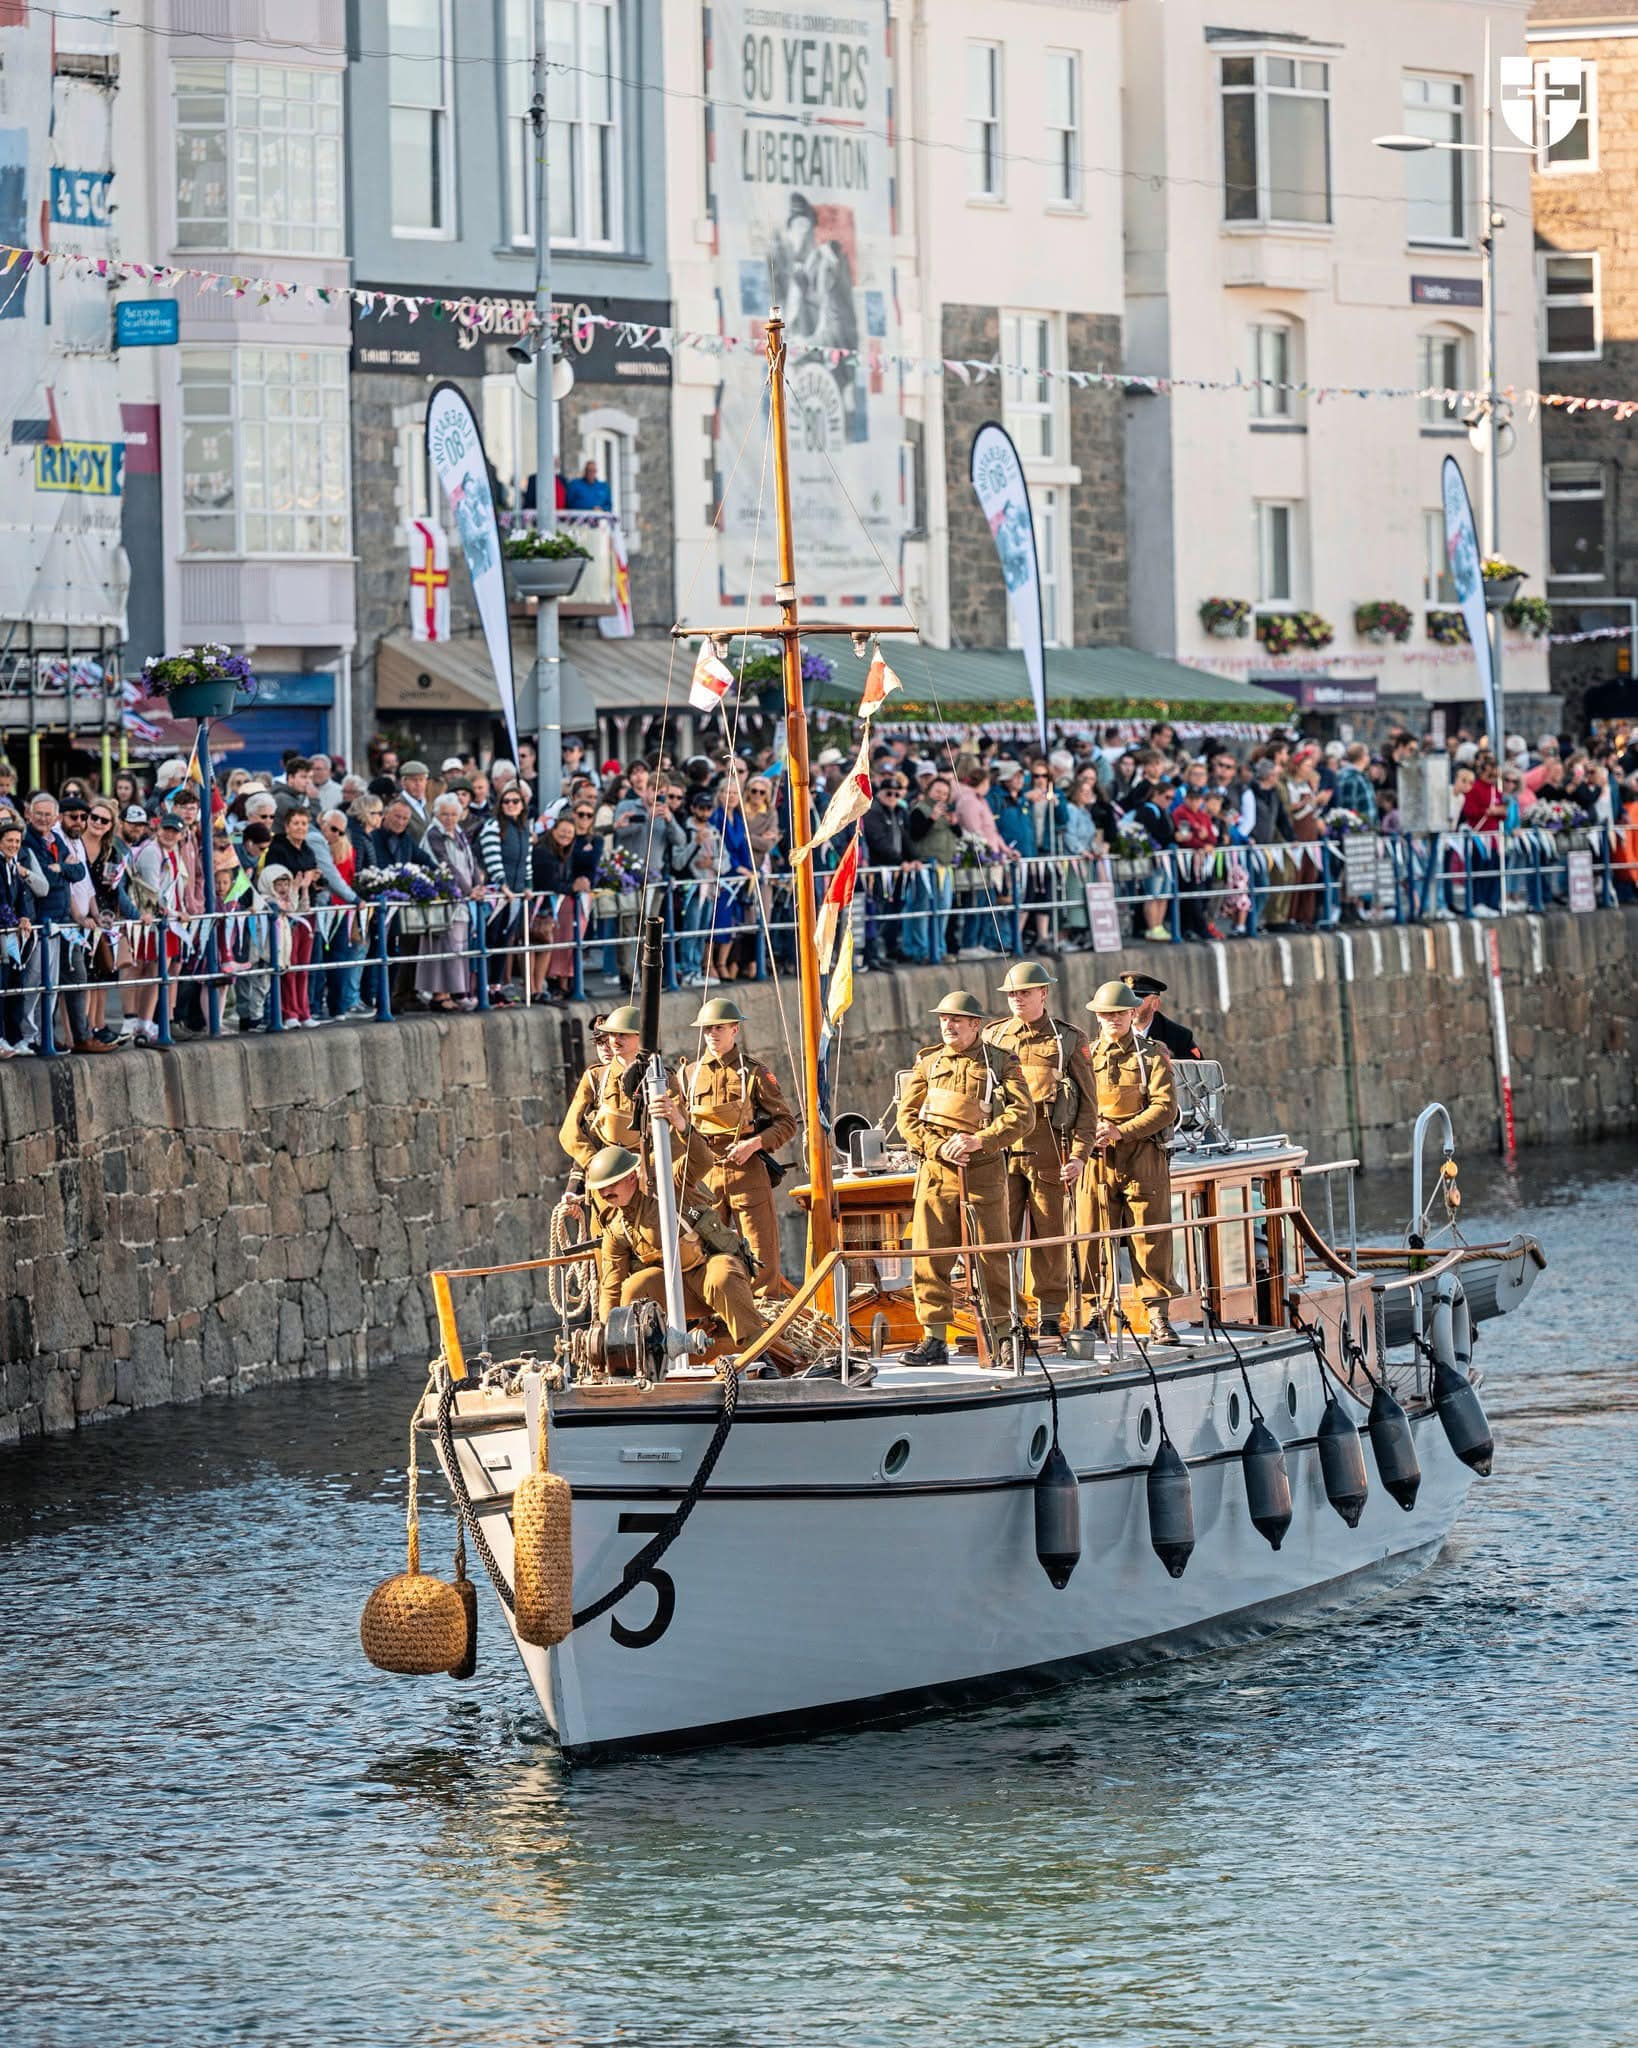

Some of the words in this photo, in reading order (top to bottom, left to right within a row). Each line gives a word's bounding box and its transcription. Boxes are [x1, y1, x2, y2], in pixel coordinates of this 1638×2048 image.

[743, 33, 772, 102] 80
[782, 38, 869, 110] YEARS
[743, 128, 869, 190] LIBERATION
[610, 1513, 680, 1649] 3
